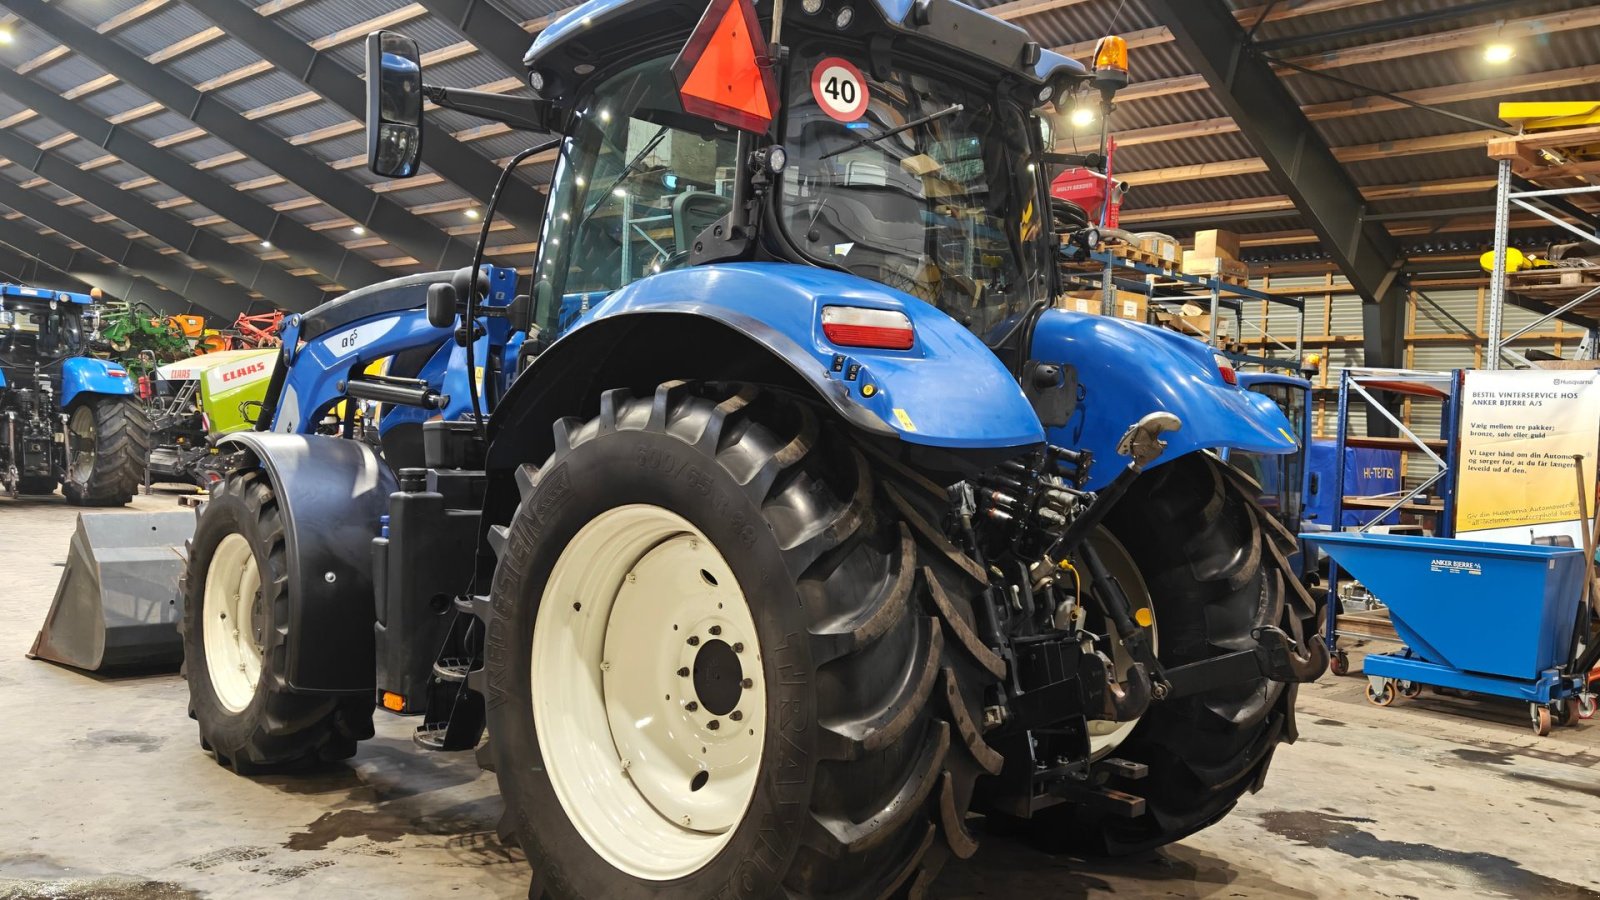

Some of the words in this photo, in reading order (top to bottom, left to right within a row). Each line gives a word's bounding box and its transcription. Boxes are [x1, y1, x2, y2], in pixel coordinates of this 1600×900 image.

[825, 76, 855, 104] 40
[171, 369, 191, 379] CLAAS
[222, 362, 265, 382] CLAAS
[1470, 422, 1487, 430] Vælg
[1470, 430, 1495, 438] bronze,
[486, 511, 542, 712] VREDESTEIN
